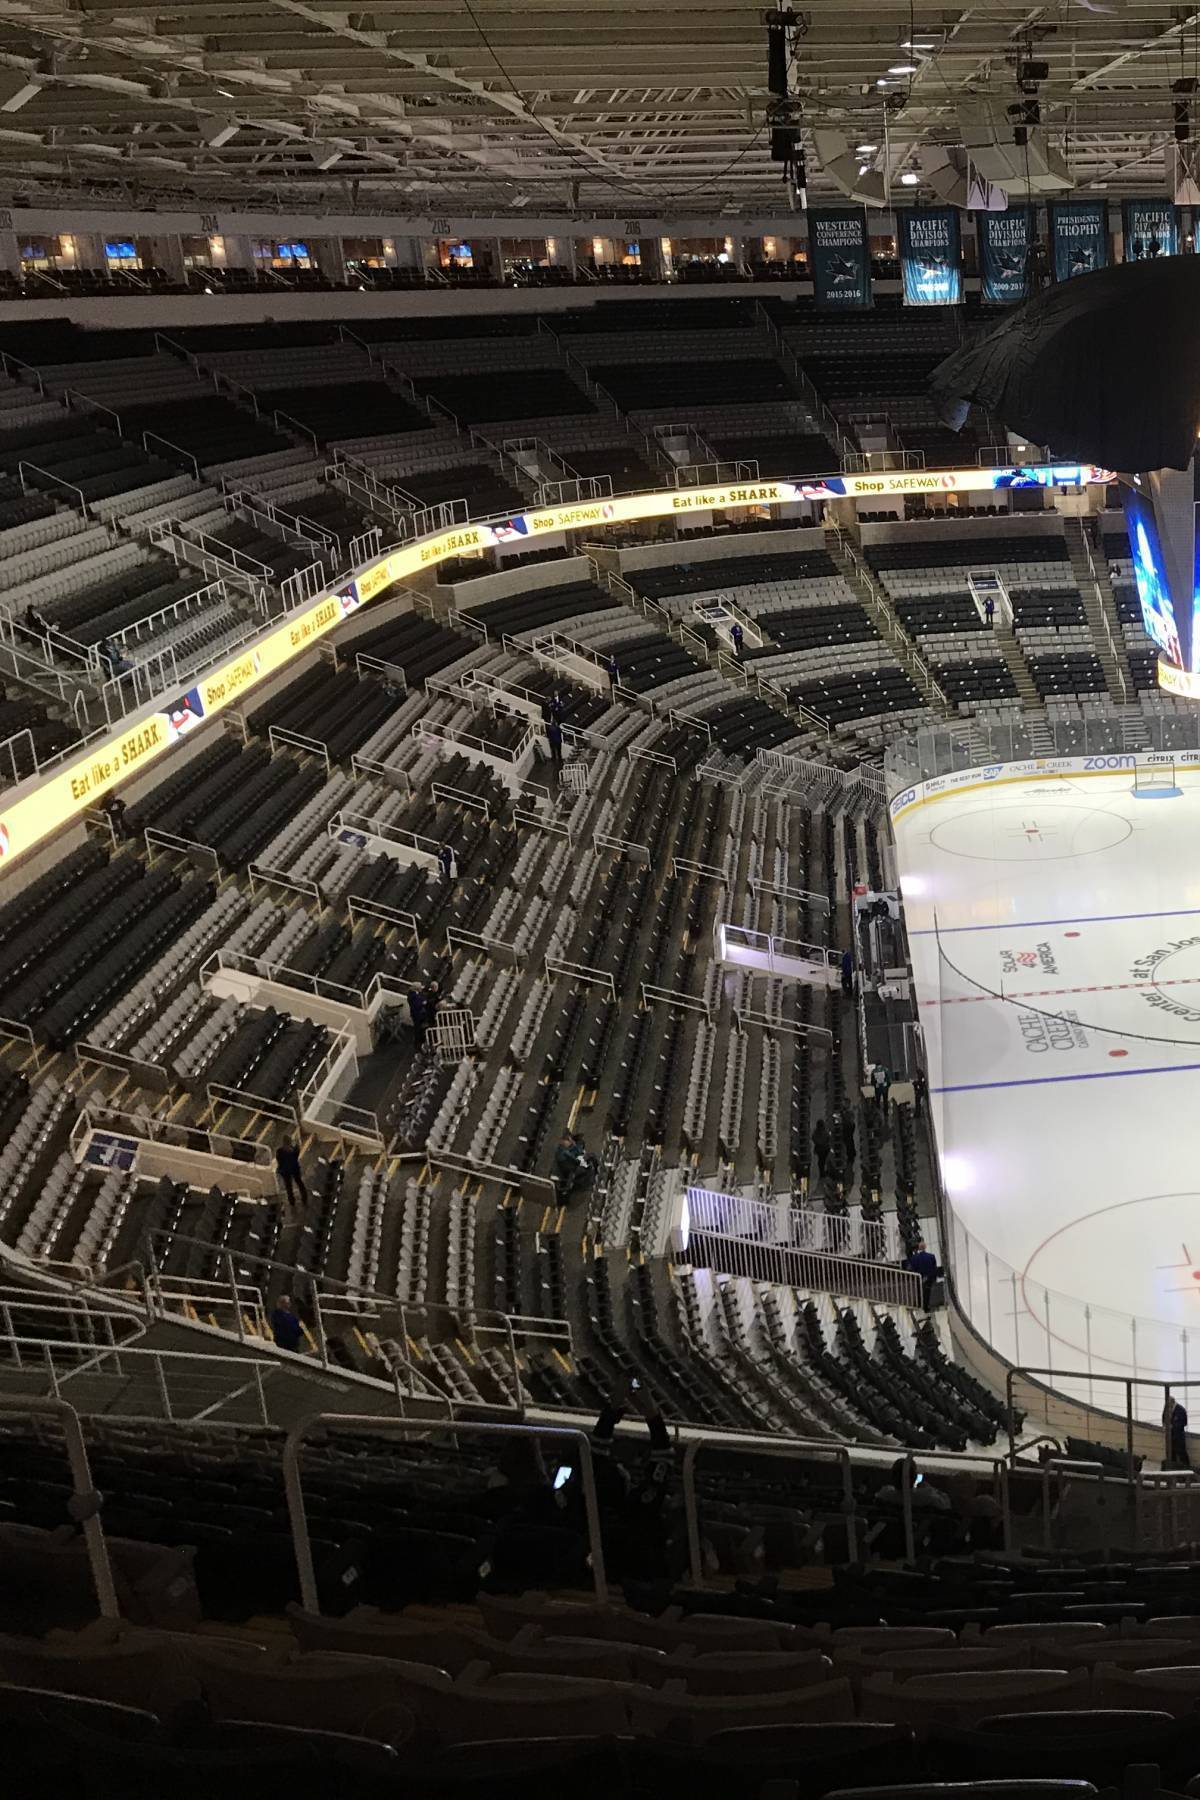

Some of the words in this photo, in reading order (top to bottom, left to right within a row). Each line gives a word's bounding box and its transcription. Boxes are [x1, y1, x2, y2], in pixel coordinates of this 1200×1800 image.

[201, 215, 220, 232] 204
[1134, 211, 1171, 222] PACIFIC
[431, 219, 451, 235] 205
[624, 221, 641, 235] 206
[816, 219, 862, 231] WESTERN
[909, 219, 949, 231] PACIFIC
[988, 219, 1026, 231] PACIFIC
[1057, 223, 1101, 237] TROPHY
[816, 230, 863, 239] CONFERENCE
[910, 230, 949, 240] DIVISION
[988, 230, 1026, 239] DIVISION
[817, 238, 863, 247] CHAMPIONS
[910, 239, 950, 248] CHAMPIONS
[989, 238, 1027, 247] CHAMPIONS
[854, 480, 885, 493] Shop
[889, 477, 940, 490] SAFEWAY
[672, 497, 693, 508] Eat
[695, 494, 716, 506] like
[719, 494, 726, 503] a
[533, 517, 554, 530] Shop
[558, 507, 601, 525] SAFEWAY
[420, 548, 432, 562] Eat
[206, 683, 226, 705] Shop
[1046, 760, 1073, 768] CREEK
[1083, 754, 1137, 771] zoom
[984, 767, 1001, 779] SAP
[71, 777, 92, 800] Eat
[91, 761, 112, 786] like
[999, 950, 1018, 974] SOLAR
[1036, 941, 1061, 976] AMERICA
[1133, 948, 1171, 967] San
[1129, 968, 1151, 979] at
[1017, 1012, 1050, 1054] CACHE
[1042, 1010, 1076, 1052] CREEK
